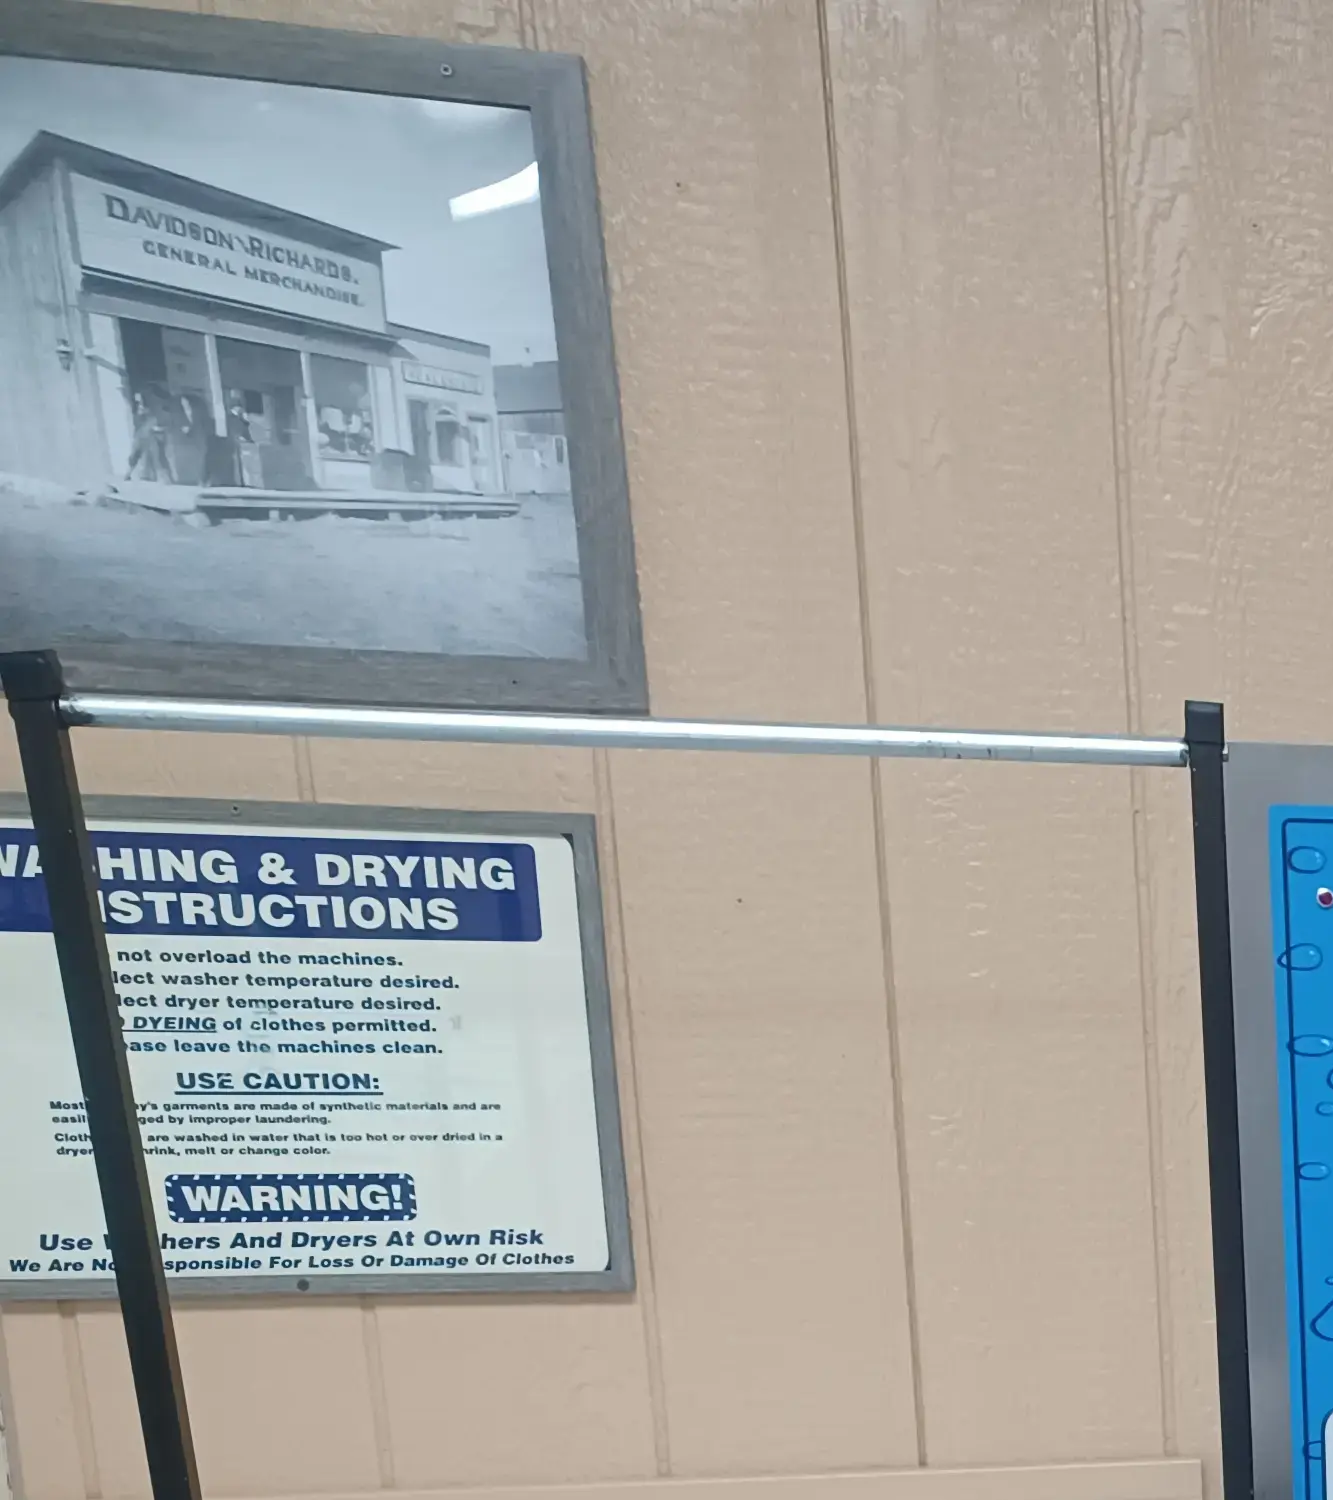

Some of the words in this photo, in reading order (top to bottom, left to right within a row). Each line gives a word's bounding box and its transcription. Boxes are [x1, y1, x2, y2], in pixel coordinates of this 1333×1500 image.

[142, 239, 238, 275] GENERAL
[0, 844, 239, 885] AHING
[257, 852, 296, 885] &
[314, 852, 516, 890] DRYING
[97, 889, 460, 931] STRUCTIONS
[117, 949, 152, 962] not
[159, 949, 252, 964] overload
[258, 951, 291, 965] the
[298, 952, 403, 966] machines.
[112, 971, 155, 984] lect
[161, 972, 239, 986] washer
[246, 974, 373, 989] temperature
[380, 975, 460, 989] desired.
[116, 993, 158, 1007] lect
[165, 994, 220, 1010] dryer
[227, 995, 354, 1011] temperature
[361, 997, 441, 1011] desired.
[133, 1016, 217, 1032] DYEING
[223, 1017, 242, 1031] of
[250, 1018, 326, 1032] clothes
[332, 1019, 437, 1034] permitted.
[174, 1039, 231, 1053] leave
[237, 1040, 271, 1053] the
[277, 1040, 376, 1054] machines
[382, 1041, 443, 1054] clean.
[176, 1072, 234, 1090] USE
[243, 1072, 380, 1090] CAUTION:
[50, 1101, 85, 1110] Most
[163, 1102, 229, 1112] garments
[233, 1103, 256, 1111] are
[260, 1102, 298, 1111] made
[302, 1102, 315, 1111] of
[319, 1102, 382, 1113] synthetic
[386, 1102, 449, 1111] materials
[452, 1102, 477, 1111] and
[480, 1103, 501, 1111] are
[52, 1115, 87, 1124] easil
[168, 1115, 185, 1125] by
[189, 1115, 251, 1125] improper
[255, 1115, 332, 1125] laundering.
[54, 1133, 92, 1142] Cloth
[147, 1134, 170, 1142] are
[174, 1133, 228, 1142] washed
[232, 1133, 246, 1142] in
[249, 1133, 289, 1142] water
[293, 1132, 321, 1142] that
[325, 1132, 337, 1142] is
[340, 1132, 362, 1142] too
[366, 1132, 389, 1142] hot
[392, 1134, 405, 1142] or
[409, 1134, 438, 1142] over
[442, 1132, 475, 1142] dried
[479, 1132, 491, 1142] in
[143, 1147, 181, 1157] hrink,
[185, 1147, 216, 1156] melt
[239, 1146, 289, 1157] change
[293, 1146, 331, 1156] color.
[181, 1184, 404, 1212] WARNING!
[39, 1233, 94, 1251] Use
[229, 1232, 282, 1250] And
[291, 1231, 378, 1251] Dryers
[385, 1230, 415, 1247] At
[423, 1230, 481, 1247] Own
[488, 1228, 545, 1246] Risk
[9, 1259, 41, 1272] We
[48, 1258, 84, 1272] Are
[91, 1258, 116, 1271] No
[163, 1256, 262, 1272] sponsible
[269, 1256, 302, 1269] For
[308, 1255, 354, 1268] Loss
[360, 1255, 385, 1268] Or
[390, 1254, 469, 1269] Damage
[475, 1253, 497, 1266] Of
[502, 1252, 575, 1266] Clothes
